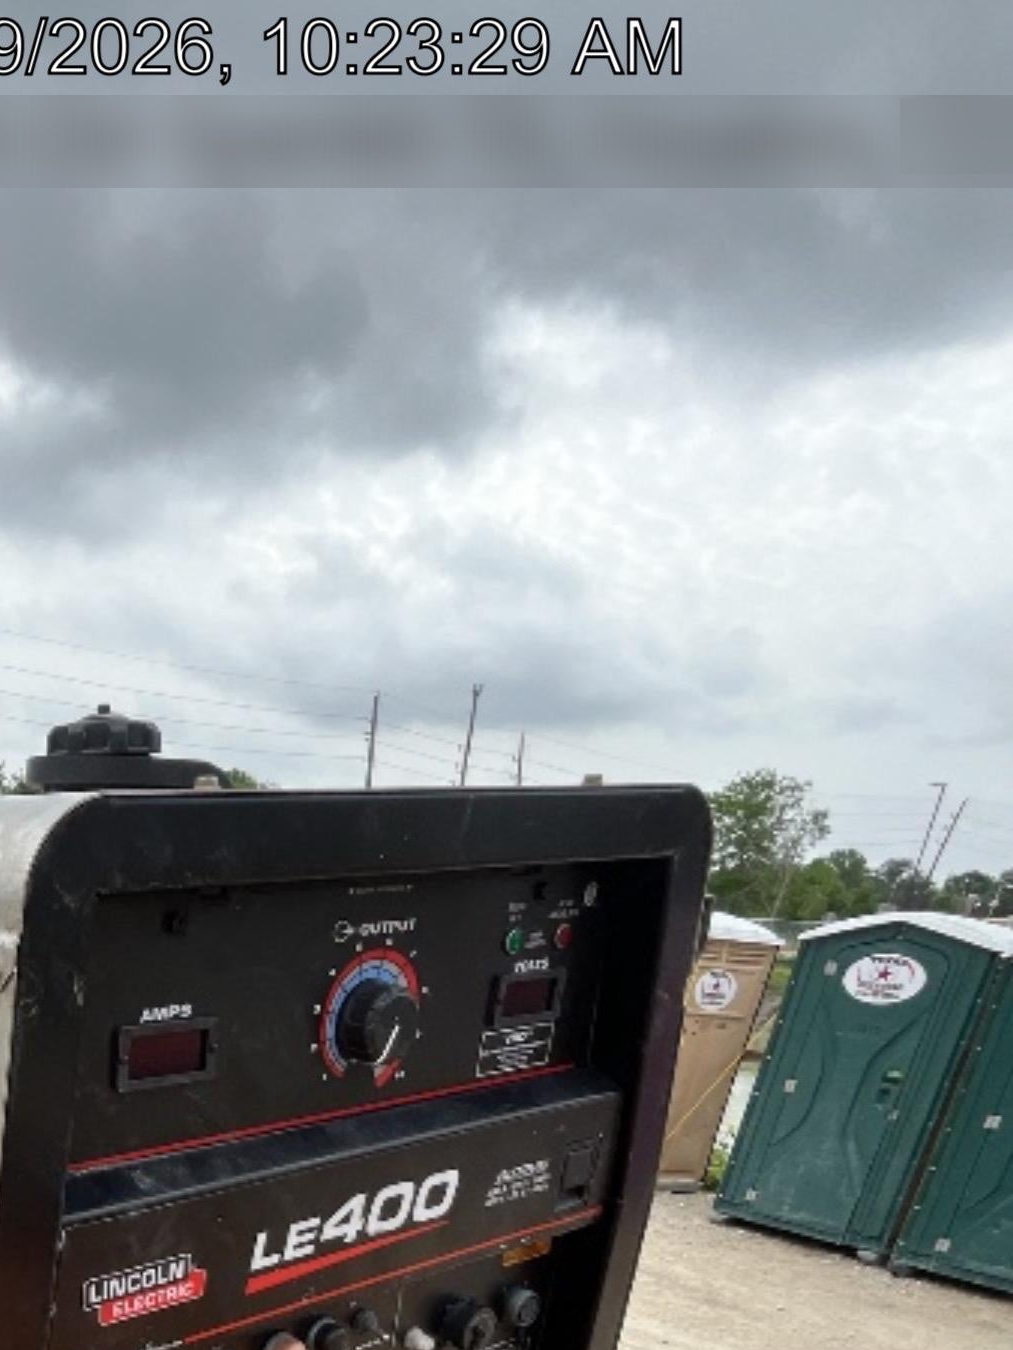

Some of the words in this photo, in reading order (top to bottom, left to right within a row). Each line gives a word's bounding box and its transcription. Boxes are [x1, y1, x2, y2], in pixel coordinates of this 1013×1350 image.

[359, 918, 418, 938] OUTPUT
[139, 1004, 193, 1024] AMPS
[250, 1169, 460, 1271] LE400
[88, 1260, 186, 1304] LINCOLN
[112, 1281, 194, 1319] ELECTRIC
